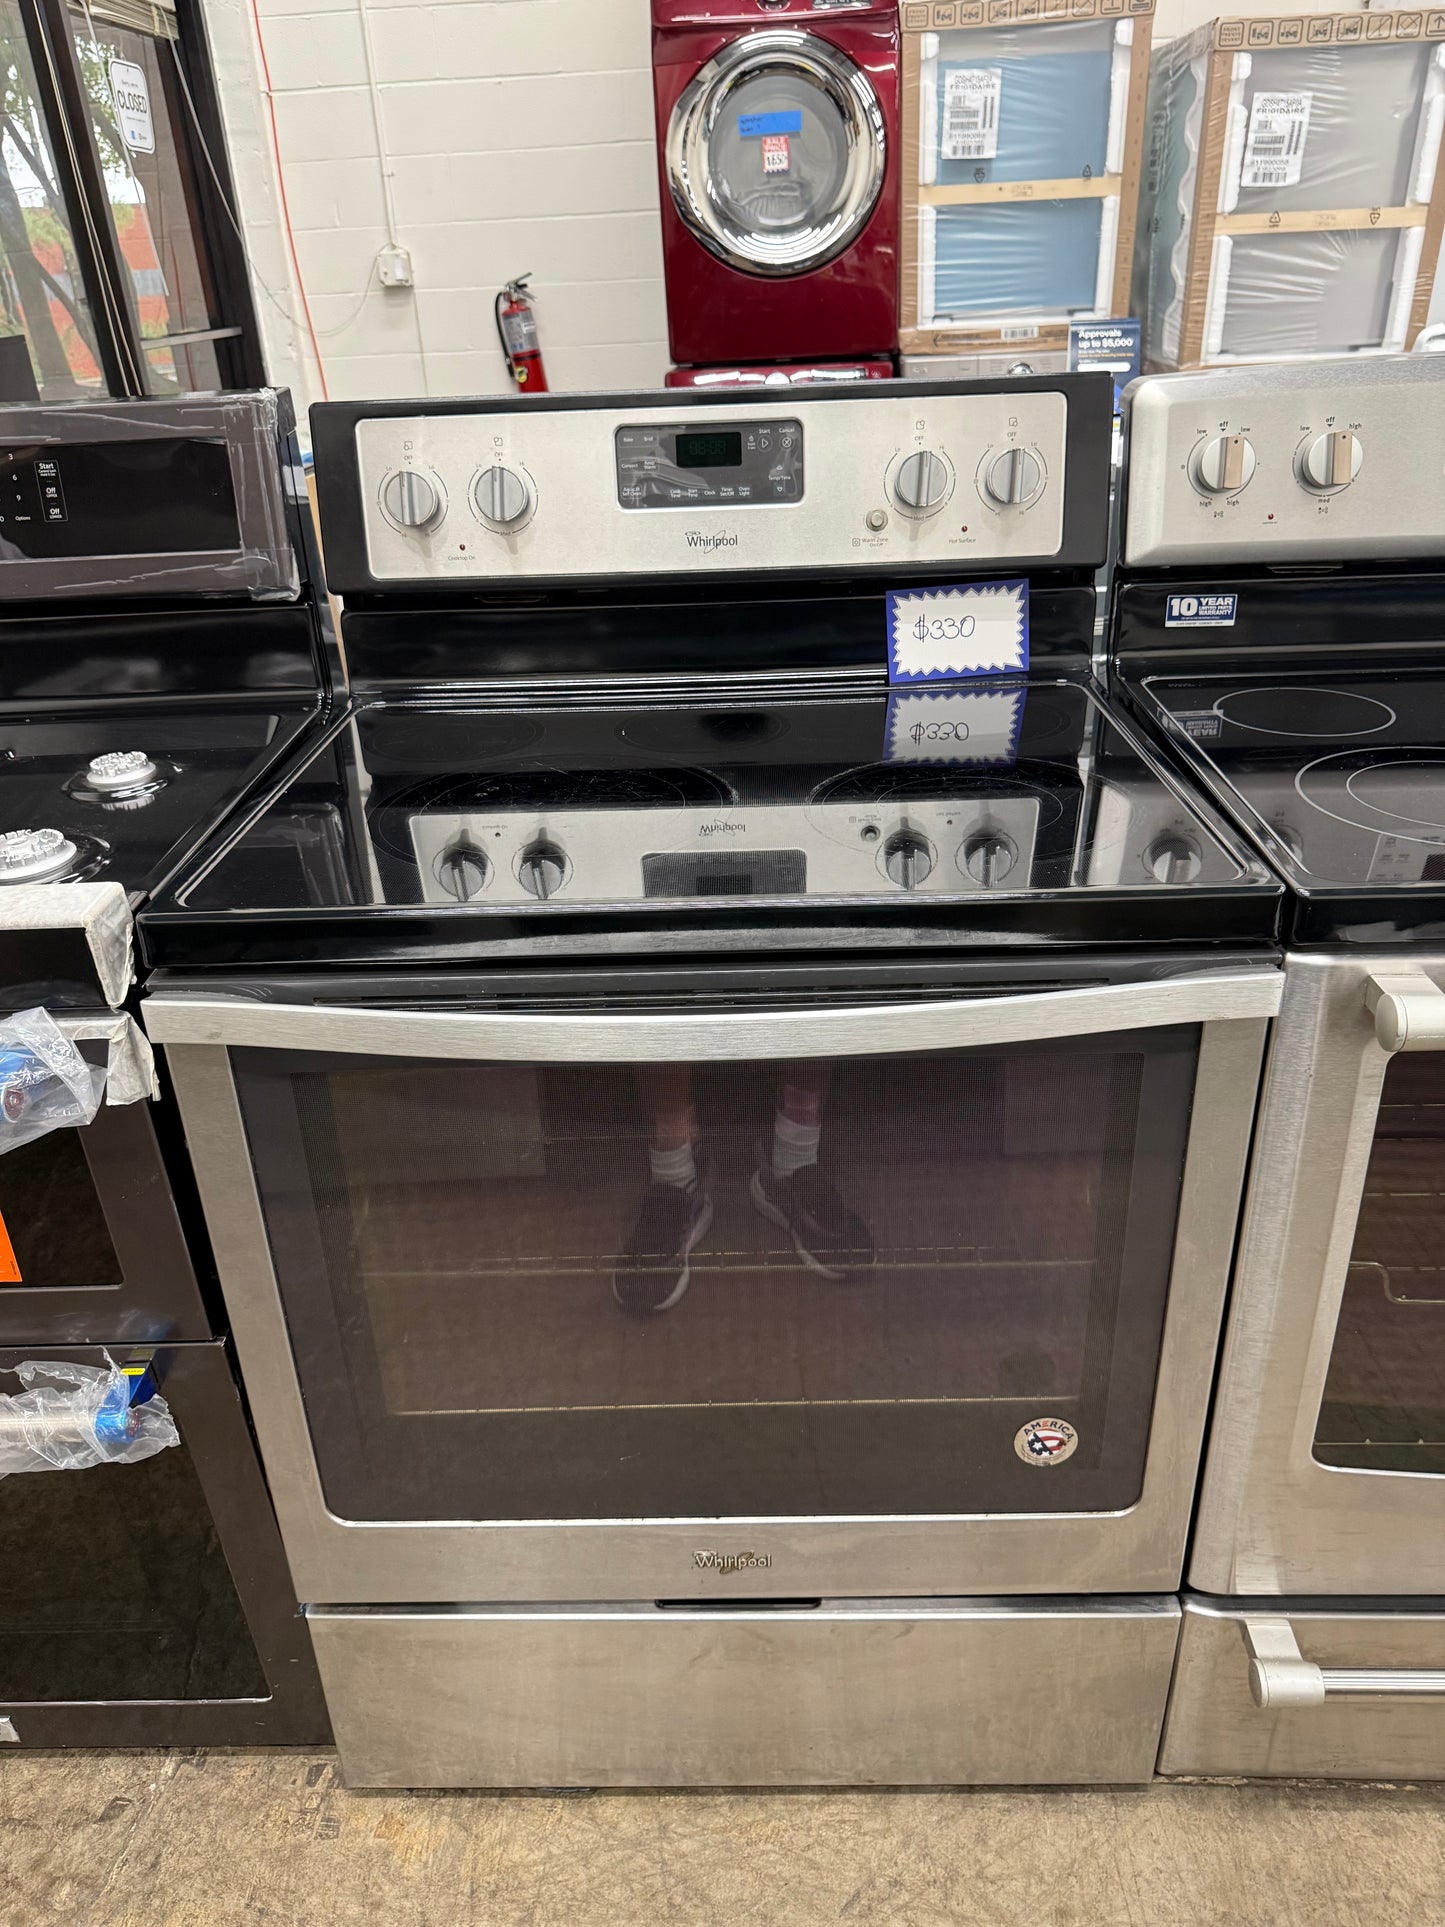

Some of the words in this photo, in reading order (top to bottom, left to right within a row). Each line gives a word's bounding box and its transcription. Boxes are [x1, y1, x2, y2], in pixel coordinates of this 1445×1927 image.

[117, 89, 147, 114] CLOSED
[1078, 329, 1122, 339] Approvals
[1079, 340, 1090, 349] up
[1091, 340, 1101, 348] to
[1102, 337, 1134, 348] $5,000
[686, 534, 738, 549] Whirlpool
[1171, 598, 1198, 617] 10
[1200, 597, 1233, 606] YEAR
[912, 613, 976, 643] $330
[1023, 1420, 1074, 1440] AMERICA
[695, 1553, 772, 1570] Whirlpool
